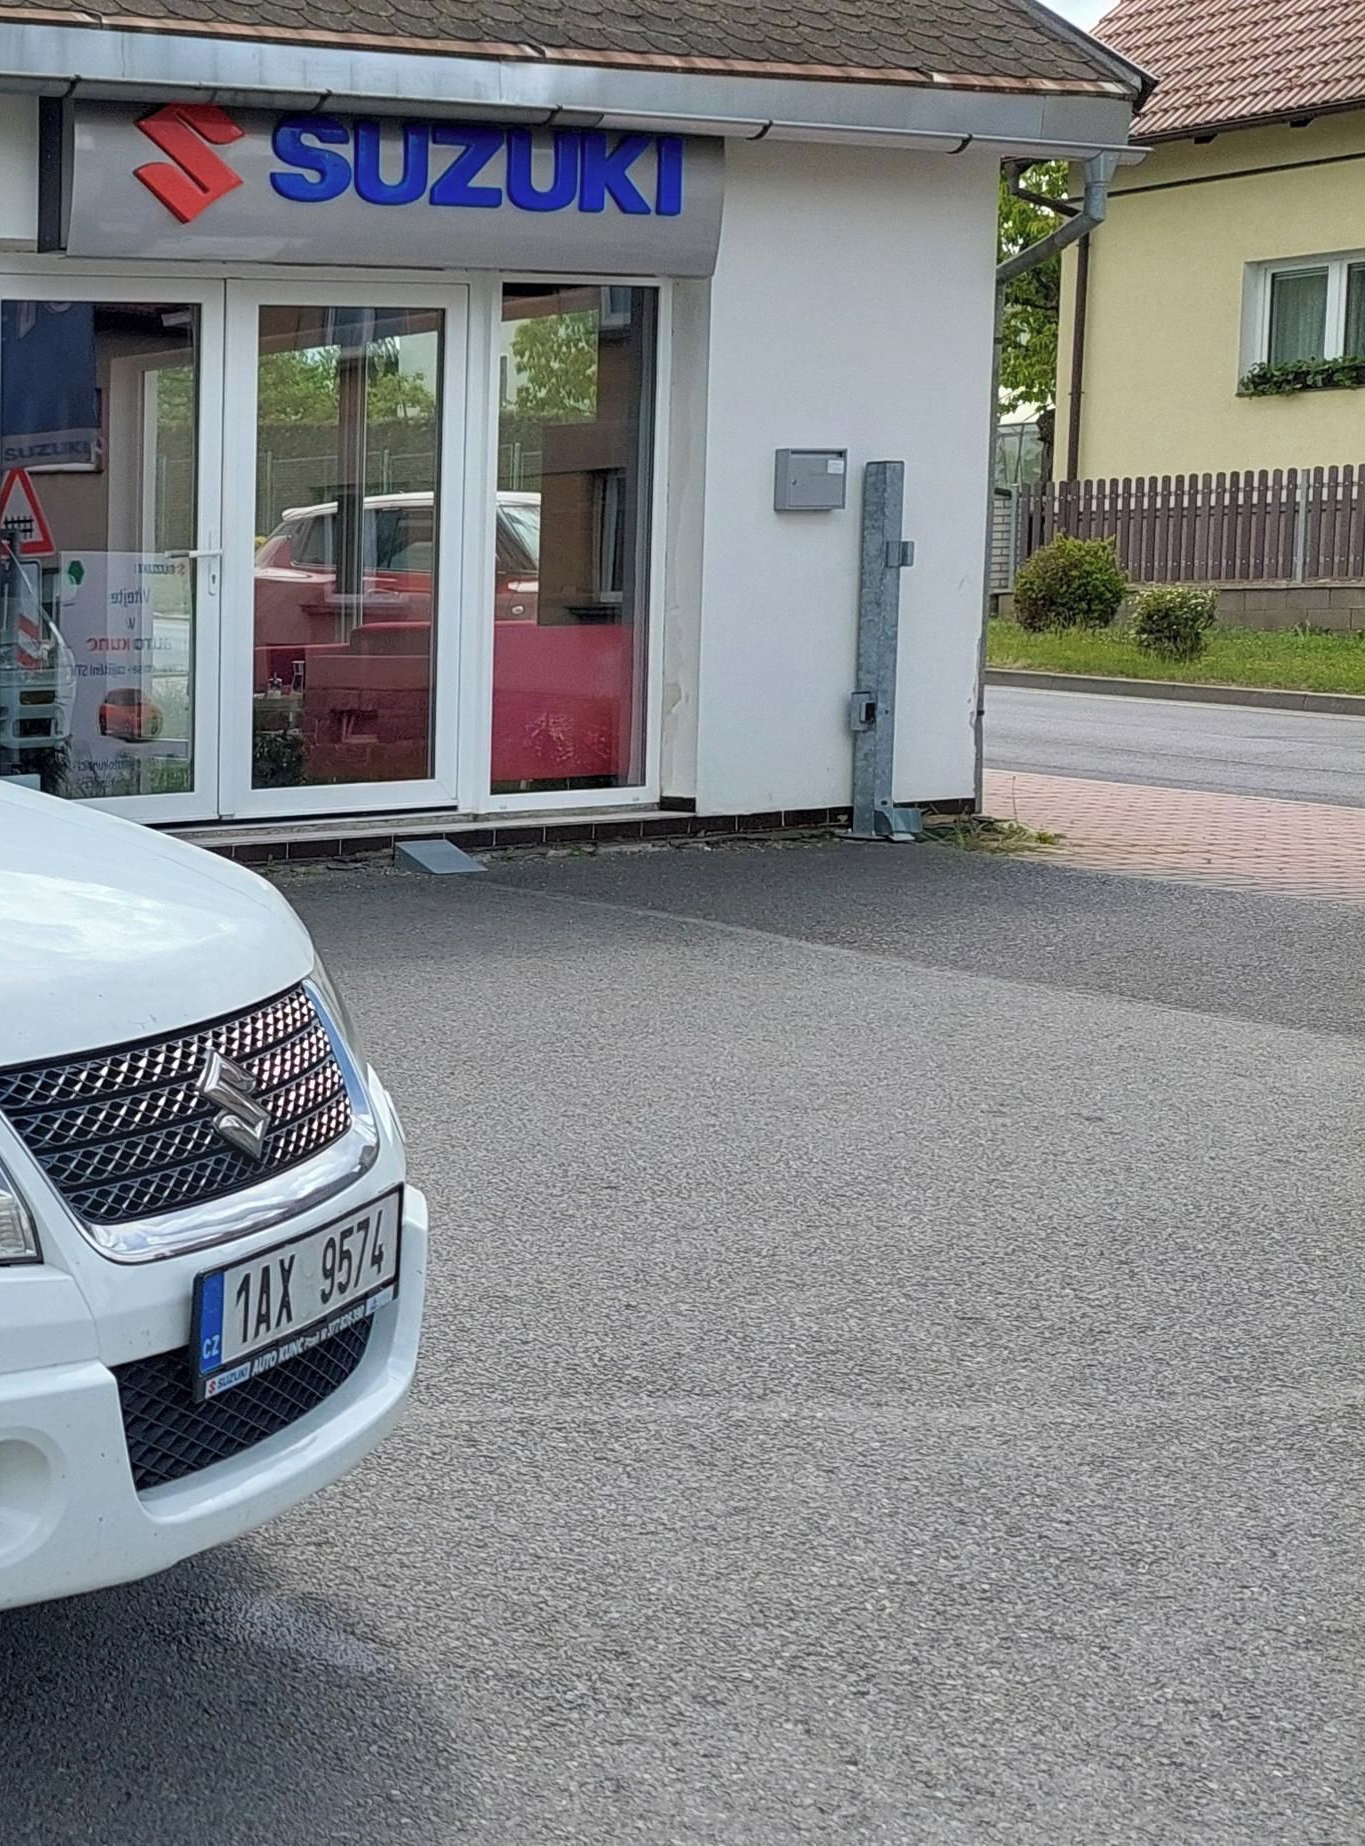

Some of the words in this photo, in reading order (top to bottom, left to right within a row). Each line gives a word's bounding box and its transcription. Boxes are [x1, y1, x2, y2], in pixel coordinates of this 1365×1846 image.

[270, 115, 683, 217] SUZUKI
[235, 1254, 296, 1344] 1AX
[320, 1209, 384, 1305] 9574
[202, 1334, 220, 1361] CZ
[217, 1367, 249, 1388] SUZUKI
[251, 1351, 278, 1376] AUTO
